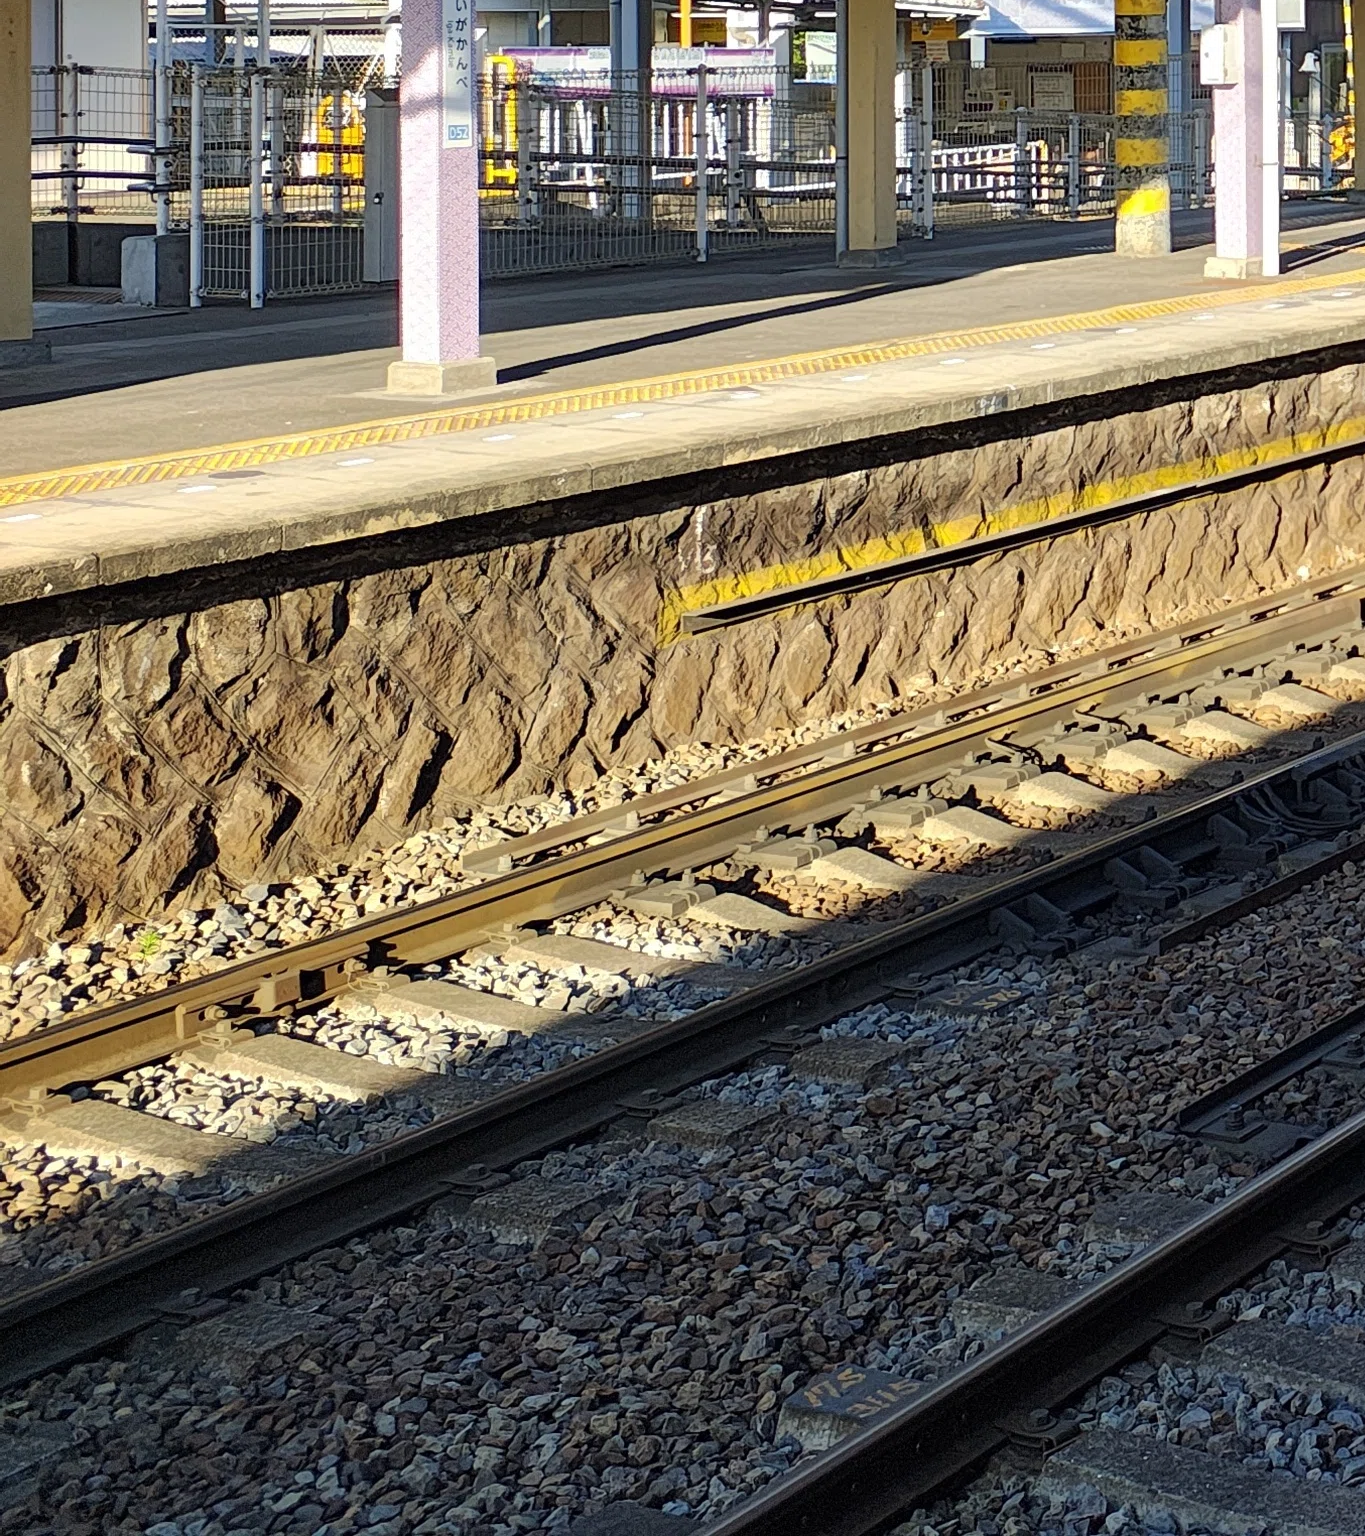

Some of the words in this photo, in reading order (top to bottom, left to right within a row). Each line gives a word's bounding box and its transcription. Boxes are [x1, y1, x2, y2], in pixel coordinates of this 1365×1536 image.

[455, 0, 468, 88] いがかんべ
